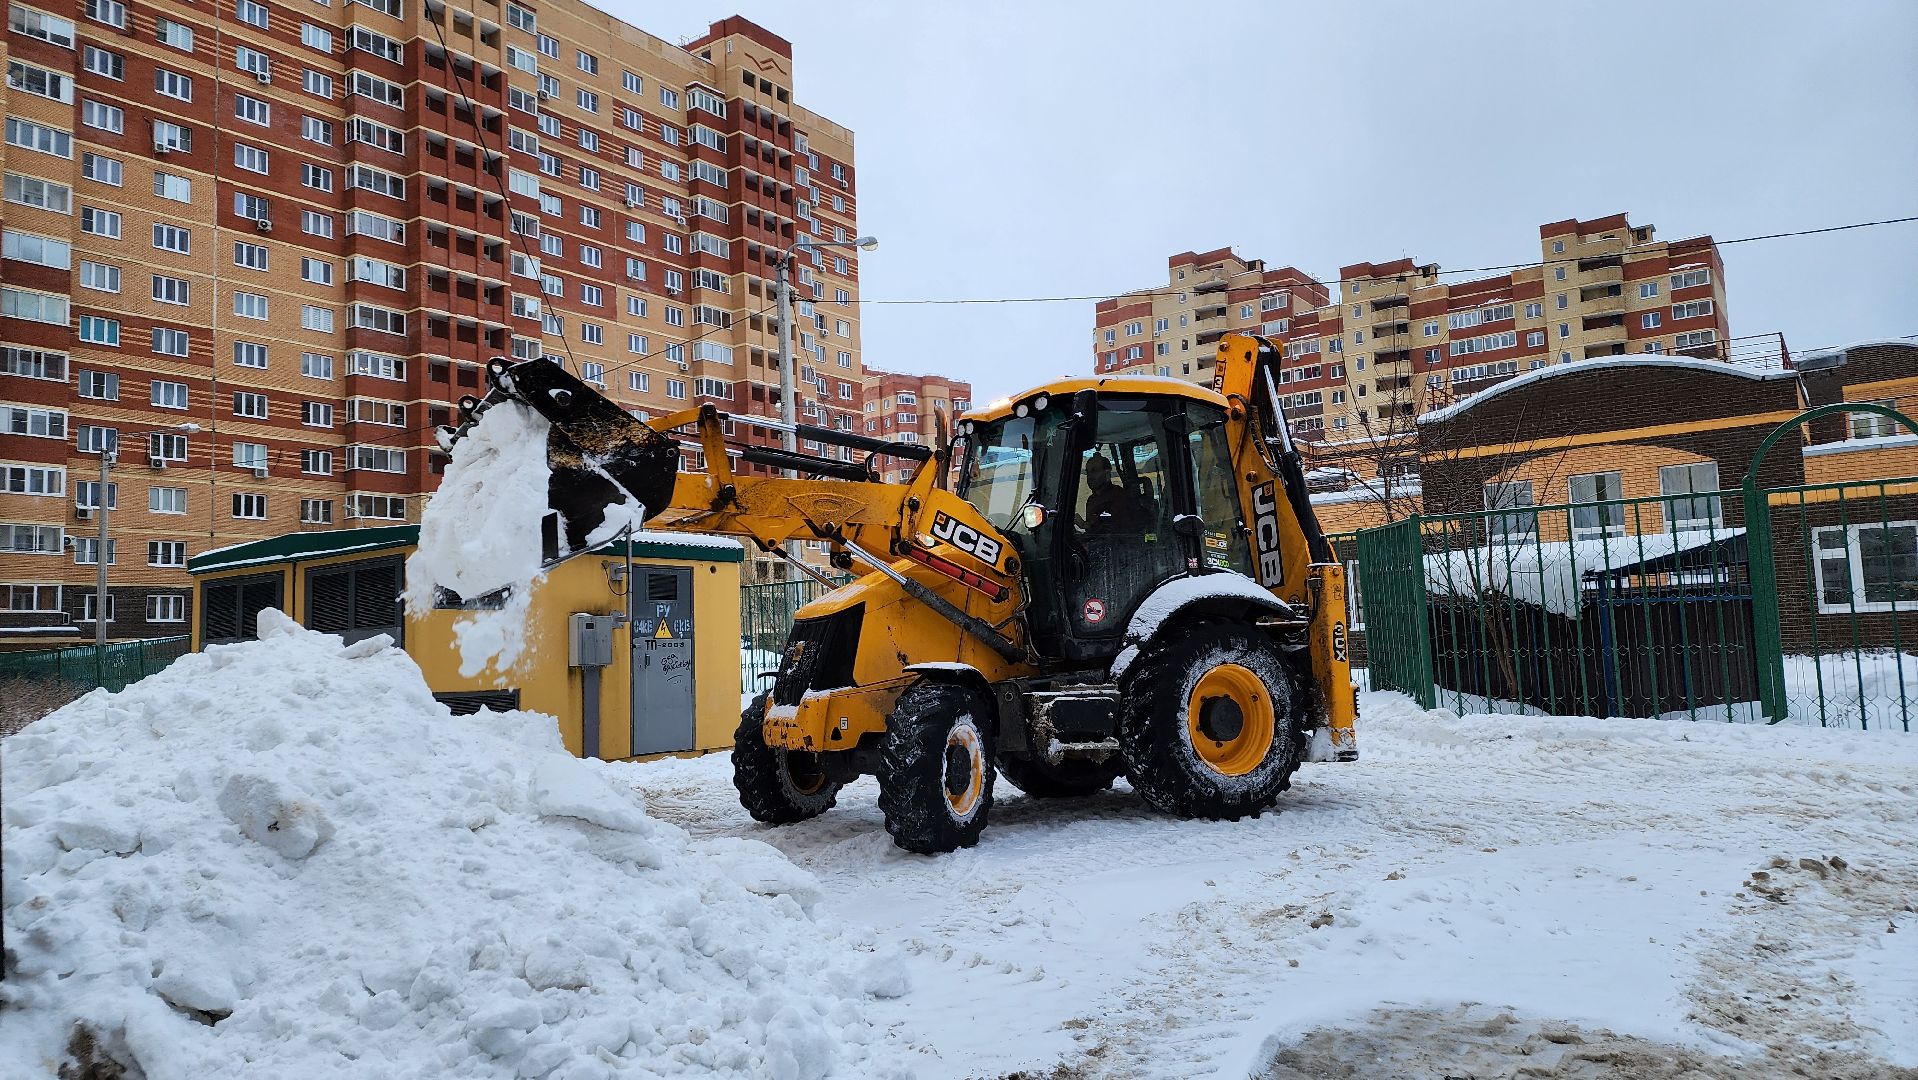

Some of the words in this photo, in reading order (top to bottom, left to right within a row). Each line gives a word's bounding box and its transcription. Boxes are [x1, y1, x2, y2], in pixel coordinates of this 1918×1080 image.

[933, 519, 1000, 564] JCB
[1254, 486, 1282, 587] JCB
[645, 639, 685, 651] ТП-2003
[1334, 624, 1347, 661] 3CX
